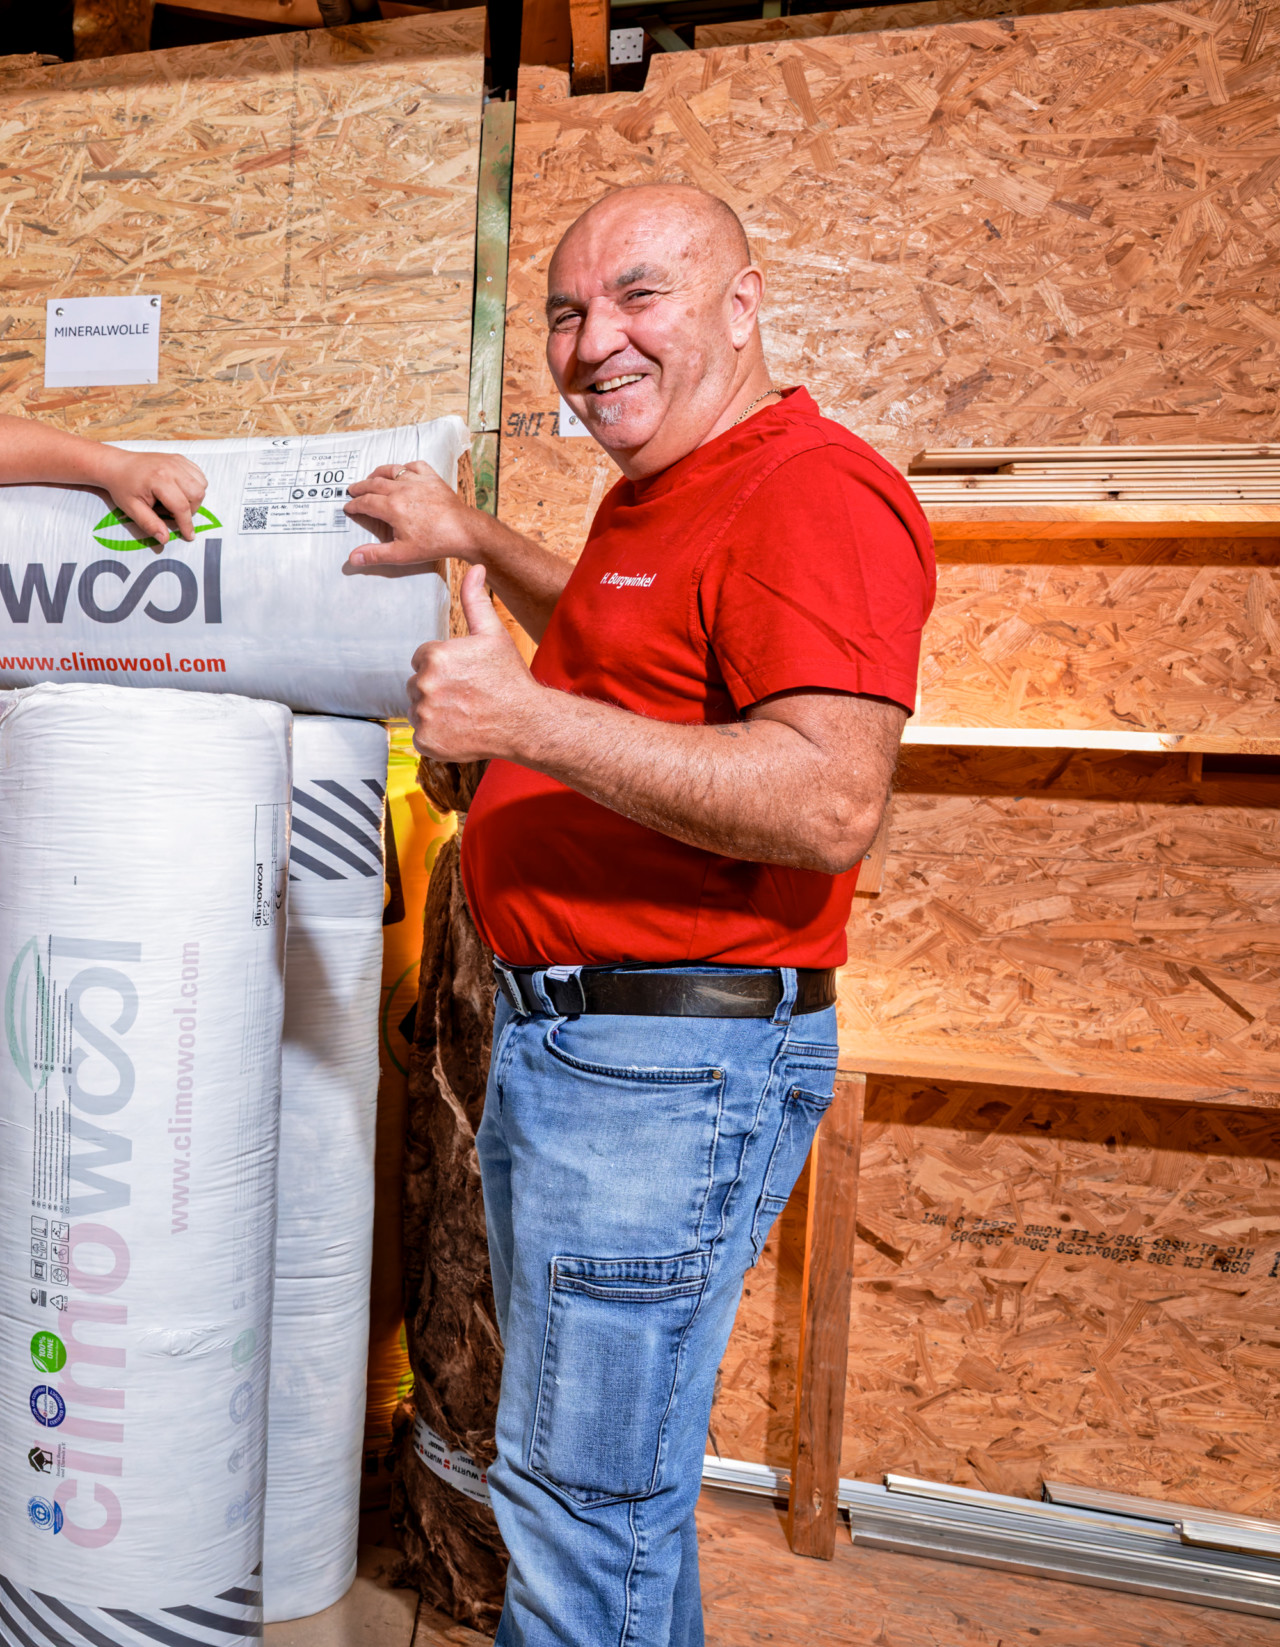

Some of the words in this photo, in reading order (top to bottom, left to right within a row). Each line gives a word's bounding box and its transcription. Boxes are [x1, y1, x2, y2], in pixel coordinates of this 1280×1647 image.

[54, 323, 150, 338] MINERALWOLLE
[314, 469, 345, 485] 100
[607, 572, 657, 589] Burgwinkel
[255, 863, 263, 926] climowool
